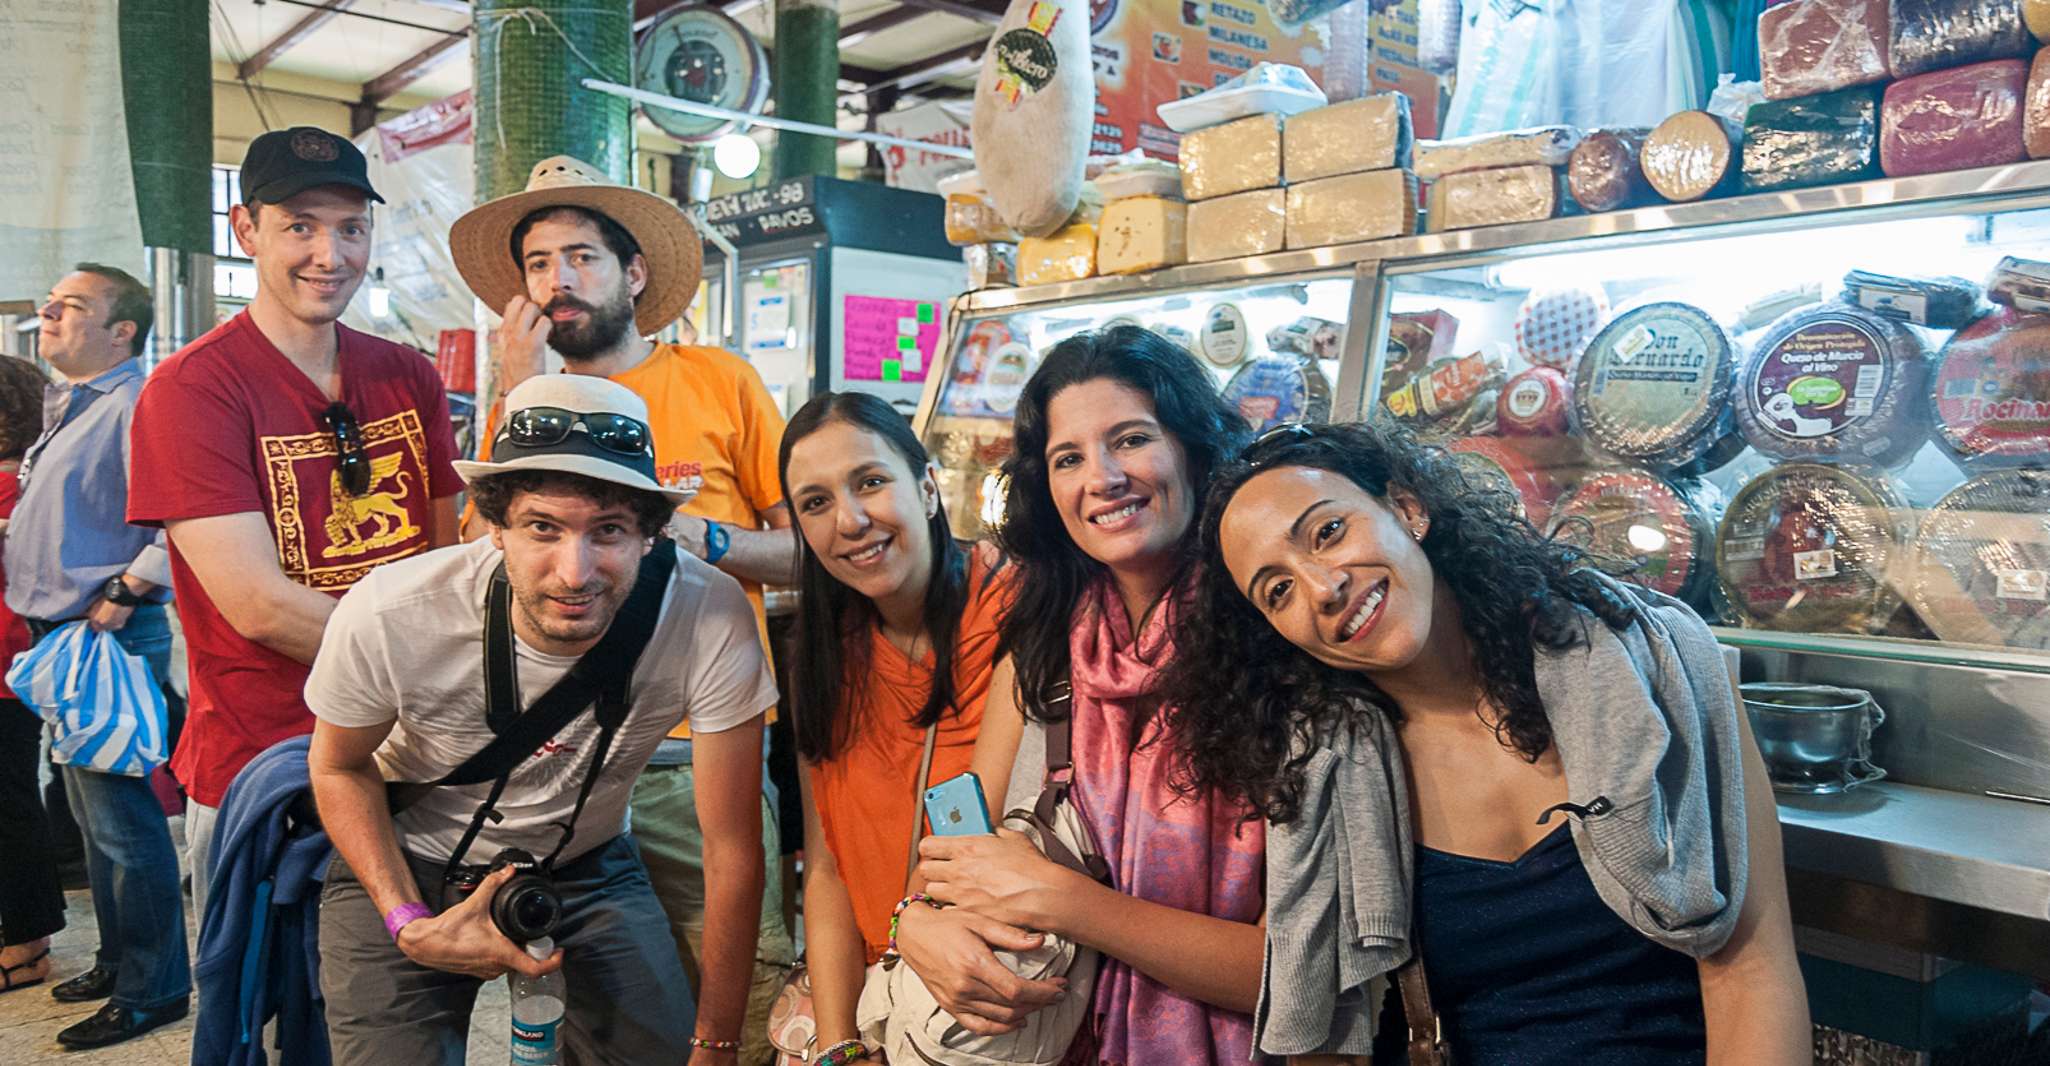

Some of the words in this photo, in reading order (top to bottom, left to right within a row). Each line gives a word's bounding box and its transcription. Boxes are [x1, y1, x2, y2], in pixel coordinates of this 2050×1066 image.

[1211, 2, 1256, 25] RETAZO
[1209, 26, 1268, 50] MILANESA
[1781, 352, 1813, 365] Queso
[1813, 352, 1827, 361] de
[1827, 350, 1865, 361] Murcia
[1802, 363, 1814, 373] al
[1814, 362, 1838, 372] Vino
[656, 460, 702, 478] eries
